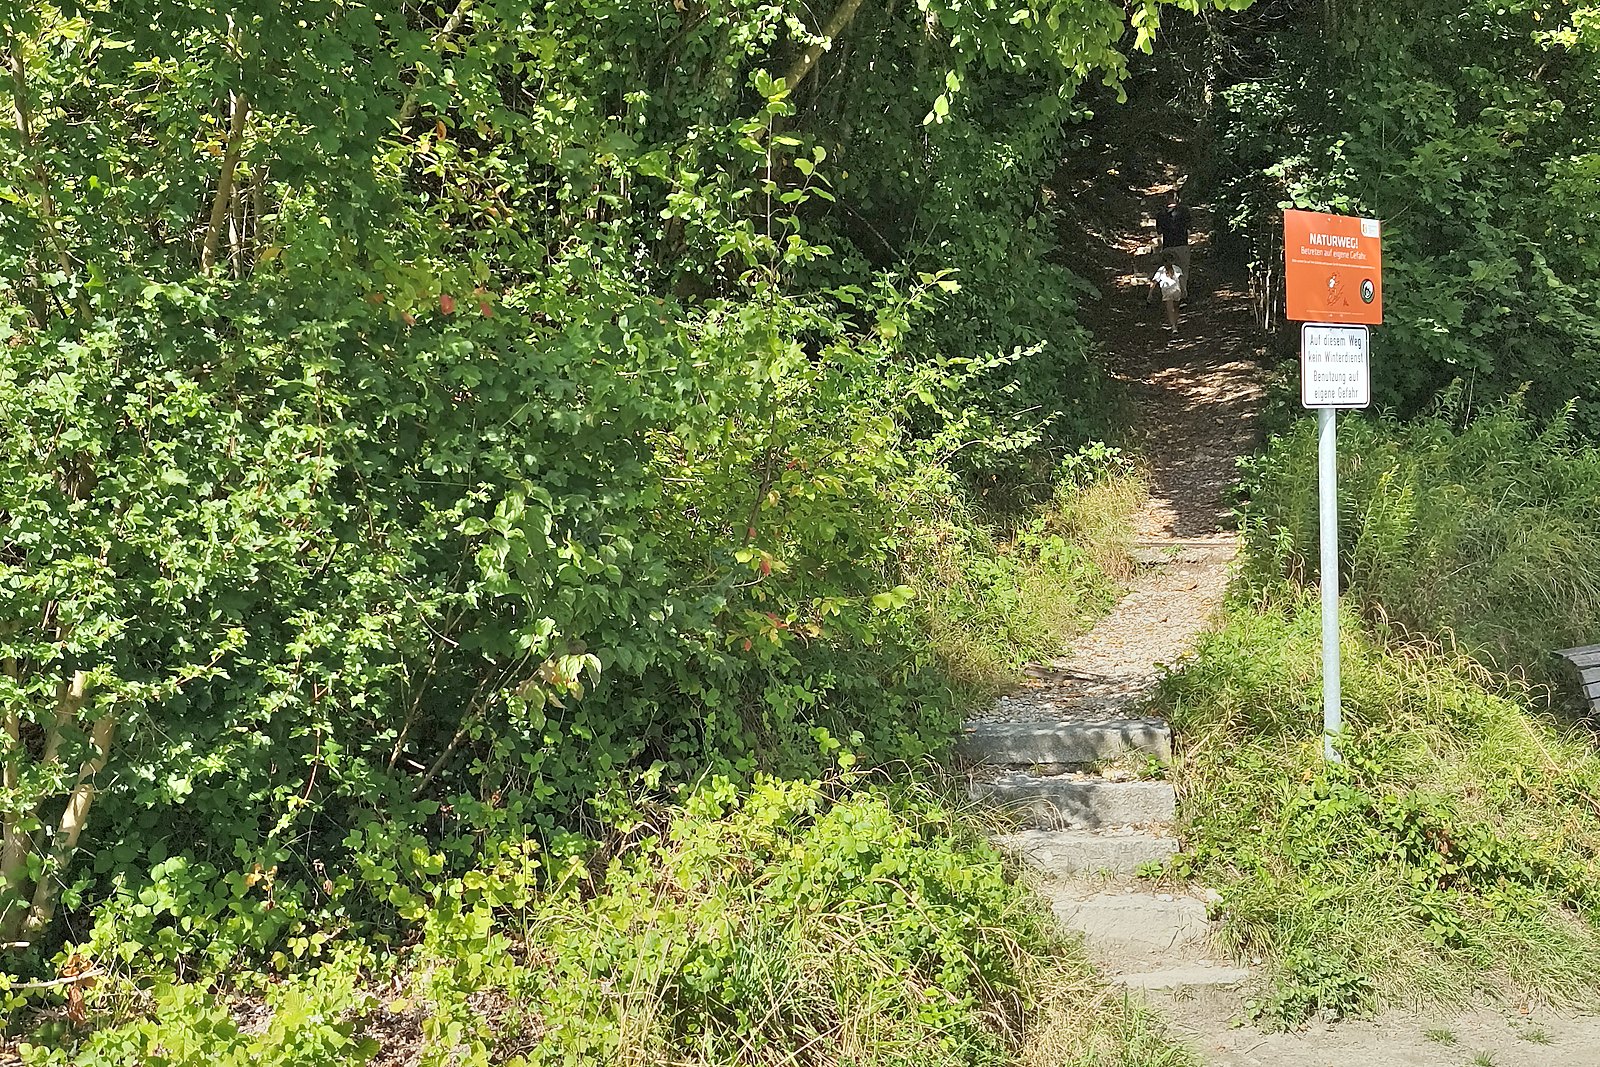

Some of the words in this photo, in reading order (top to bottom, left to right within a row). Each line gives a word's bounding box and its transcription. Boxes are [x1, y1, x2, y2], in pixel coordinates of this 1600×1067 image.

[1309, 233, 1358, 248] NATURWEG!
[1301, 246, 1323, 256] Betreten
[1324, 248, 1333, 256] auf
[1333, 250, 1349, 259] eigene
[1310, 334, 1321, 346] Auf
[1324, 334, 1346, 346] diesem
[1349, 335, 1362, 349] Weg
[1308, 350, 1322, 362] kein
[1325, 351, 1364, 363] Winterdienst
[1313, 370, 1345, 384] Benutzung
[1349, 370, 1359, 382] auf
[1314, 388, 1335, 401] eigene
[1338, 387, 1358, 398] Gefahr
